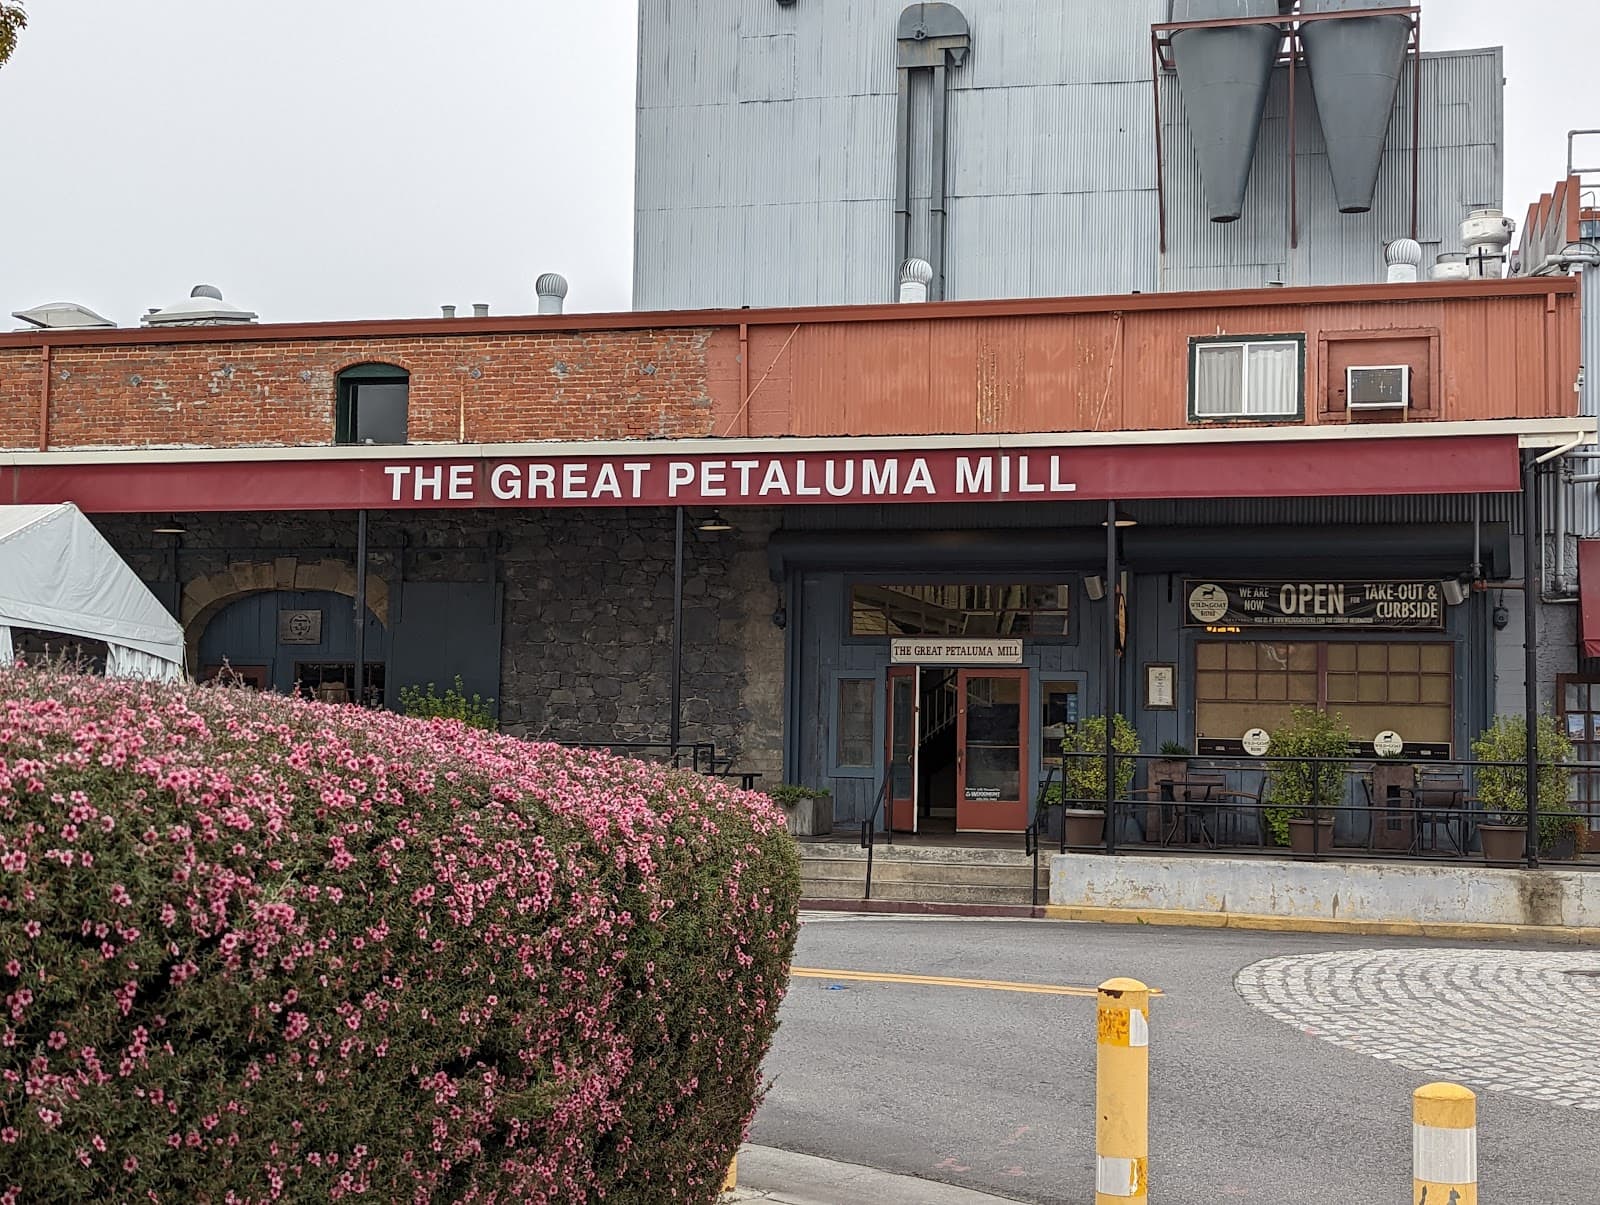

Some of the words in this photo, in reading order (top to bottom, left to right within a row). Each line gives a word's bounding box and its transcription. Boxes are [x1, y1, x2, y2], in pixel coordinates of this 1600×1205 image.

[384, 464, 474, 501] THE
[490, 462, 651, 500] GREAT
[668, 458, 937, 498] PETALUMA
[956, 455, 1076, 494] MILL
[1239, 588, 1253, 598] WE
[1254, 588, 1269, 598] ARE
[1279, 584, 1344, 615] OPEN
[1363, 584, 1425, 601] TAKE-OUT
[1427, 584, 1437, 600] &
[1244, 600, 1264, 612] NOW
[1376, 602, 1438, 619] CURBSIDE
[894, 646, 911, 656] THE
[914, 646, 942, 656] GREAT
[945, 646, 993, 656] PETALUMA
[997, 646, 1020, 656] MILL
